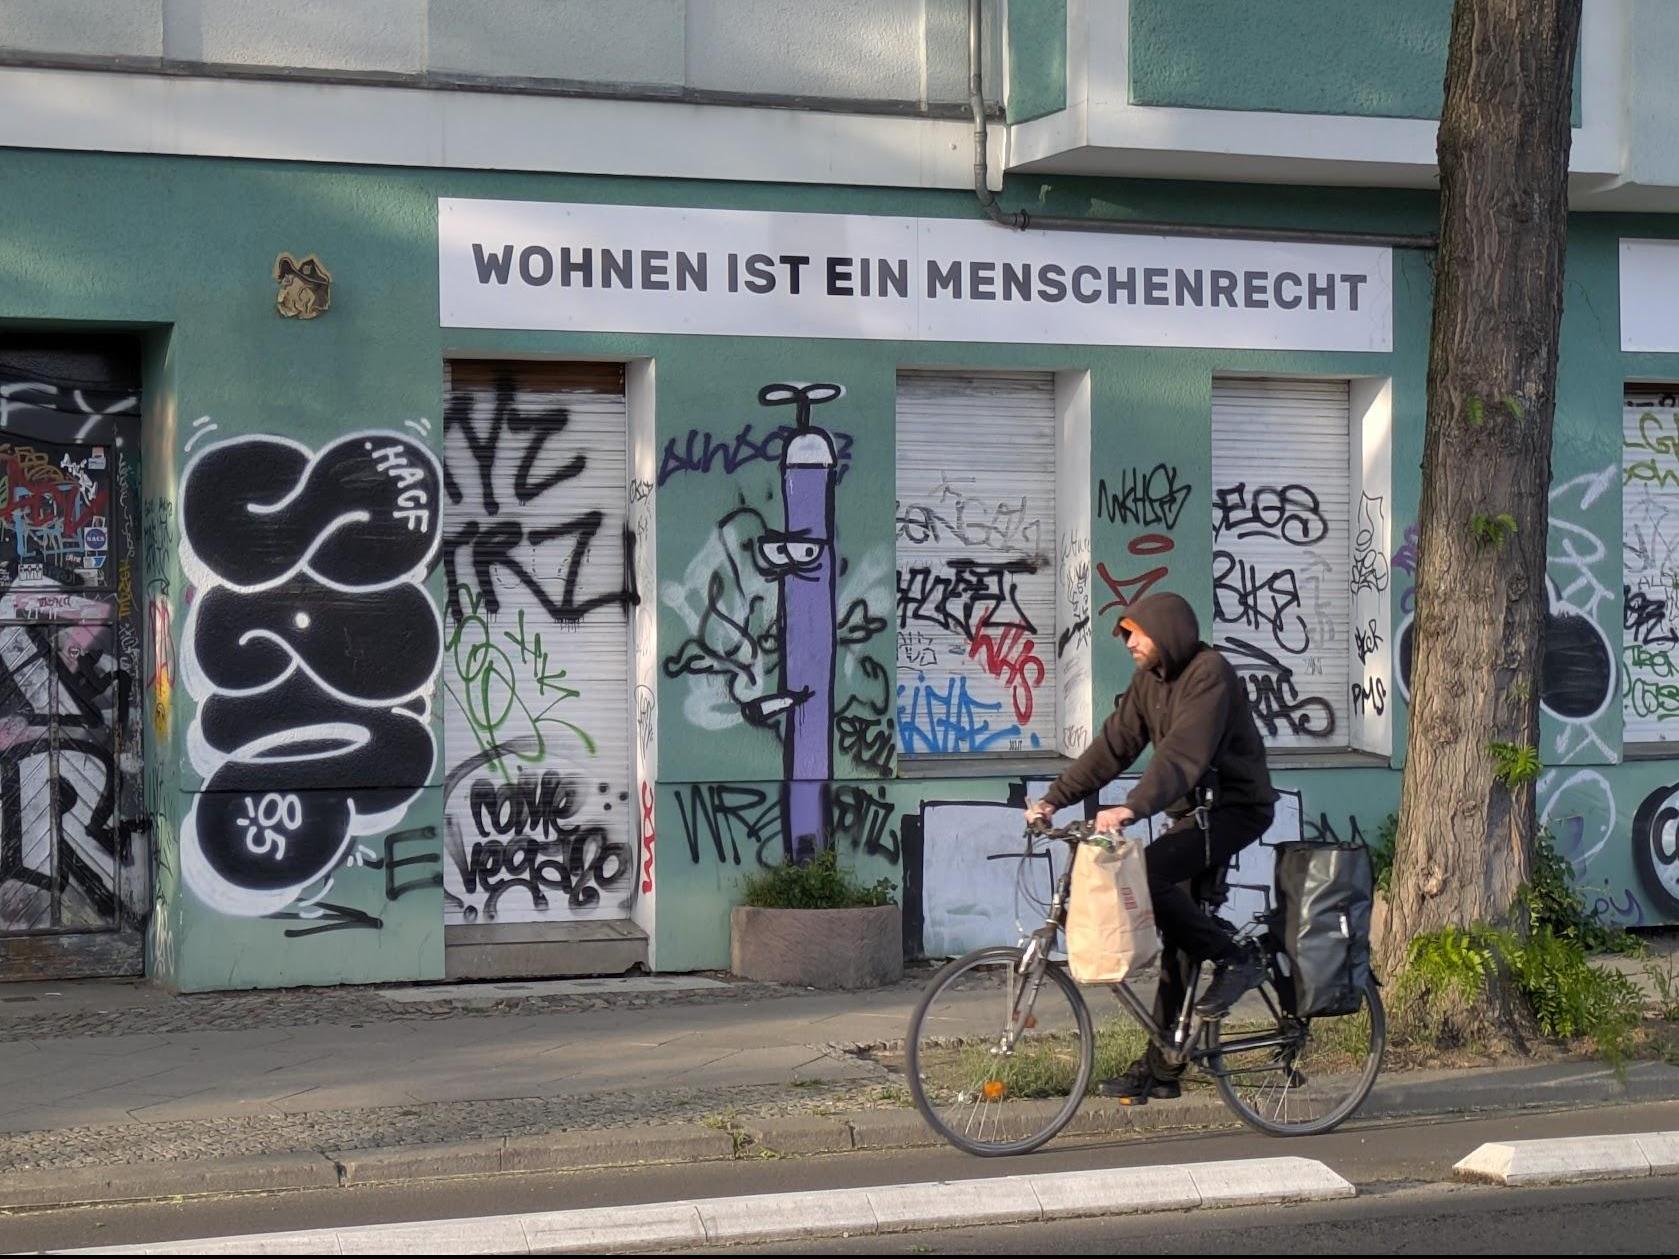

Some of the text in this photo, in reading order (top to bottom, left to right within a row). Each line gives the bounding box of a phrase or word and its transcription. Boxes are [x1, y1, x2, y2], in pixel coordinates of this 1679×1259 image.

[471, 243, 1368, 311] WOHNEN IST EIN MENSCHENRECHT
[1351, 676, 1387, 717] PMS
